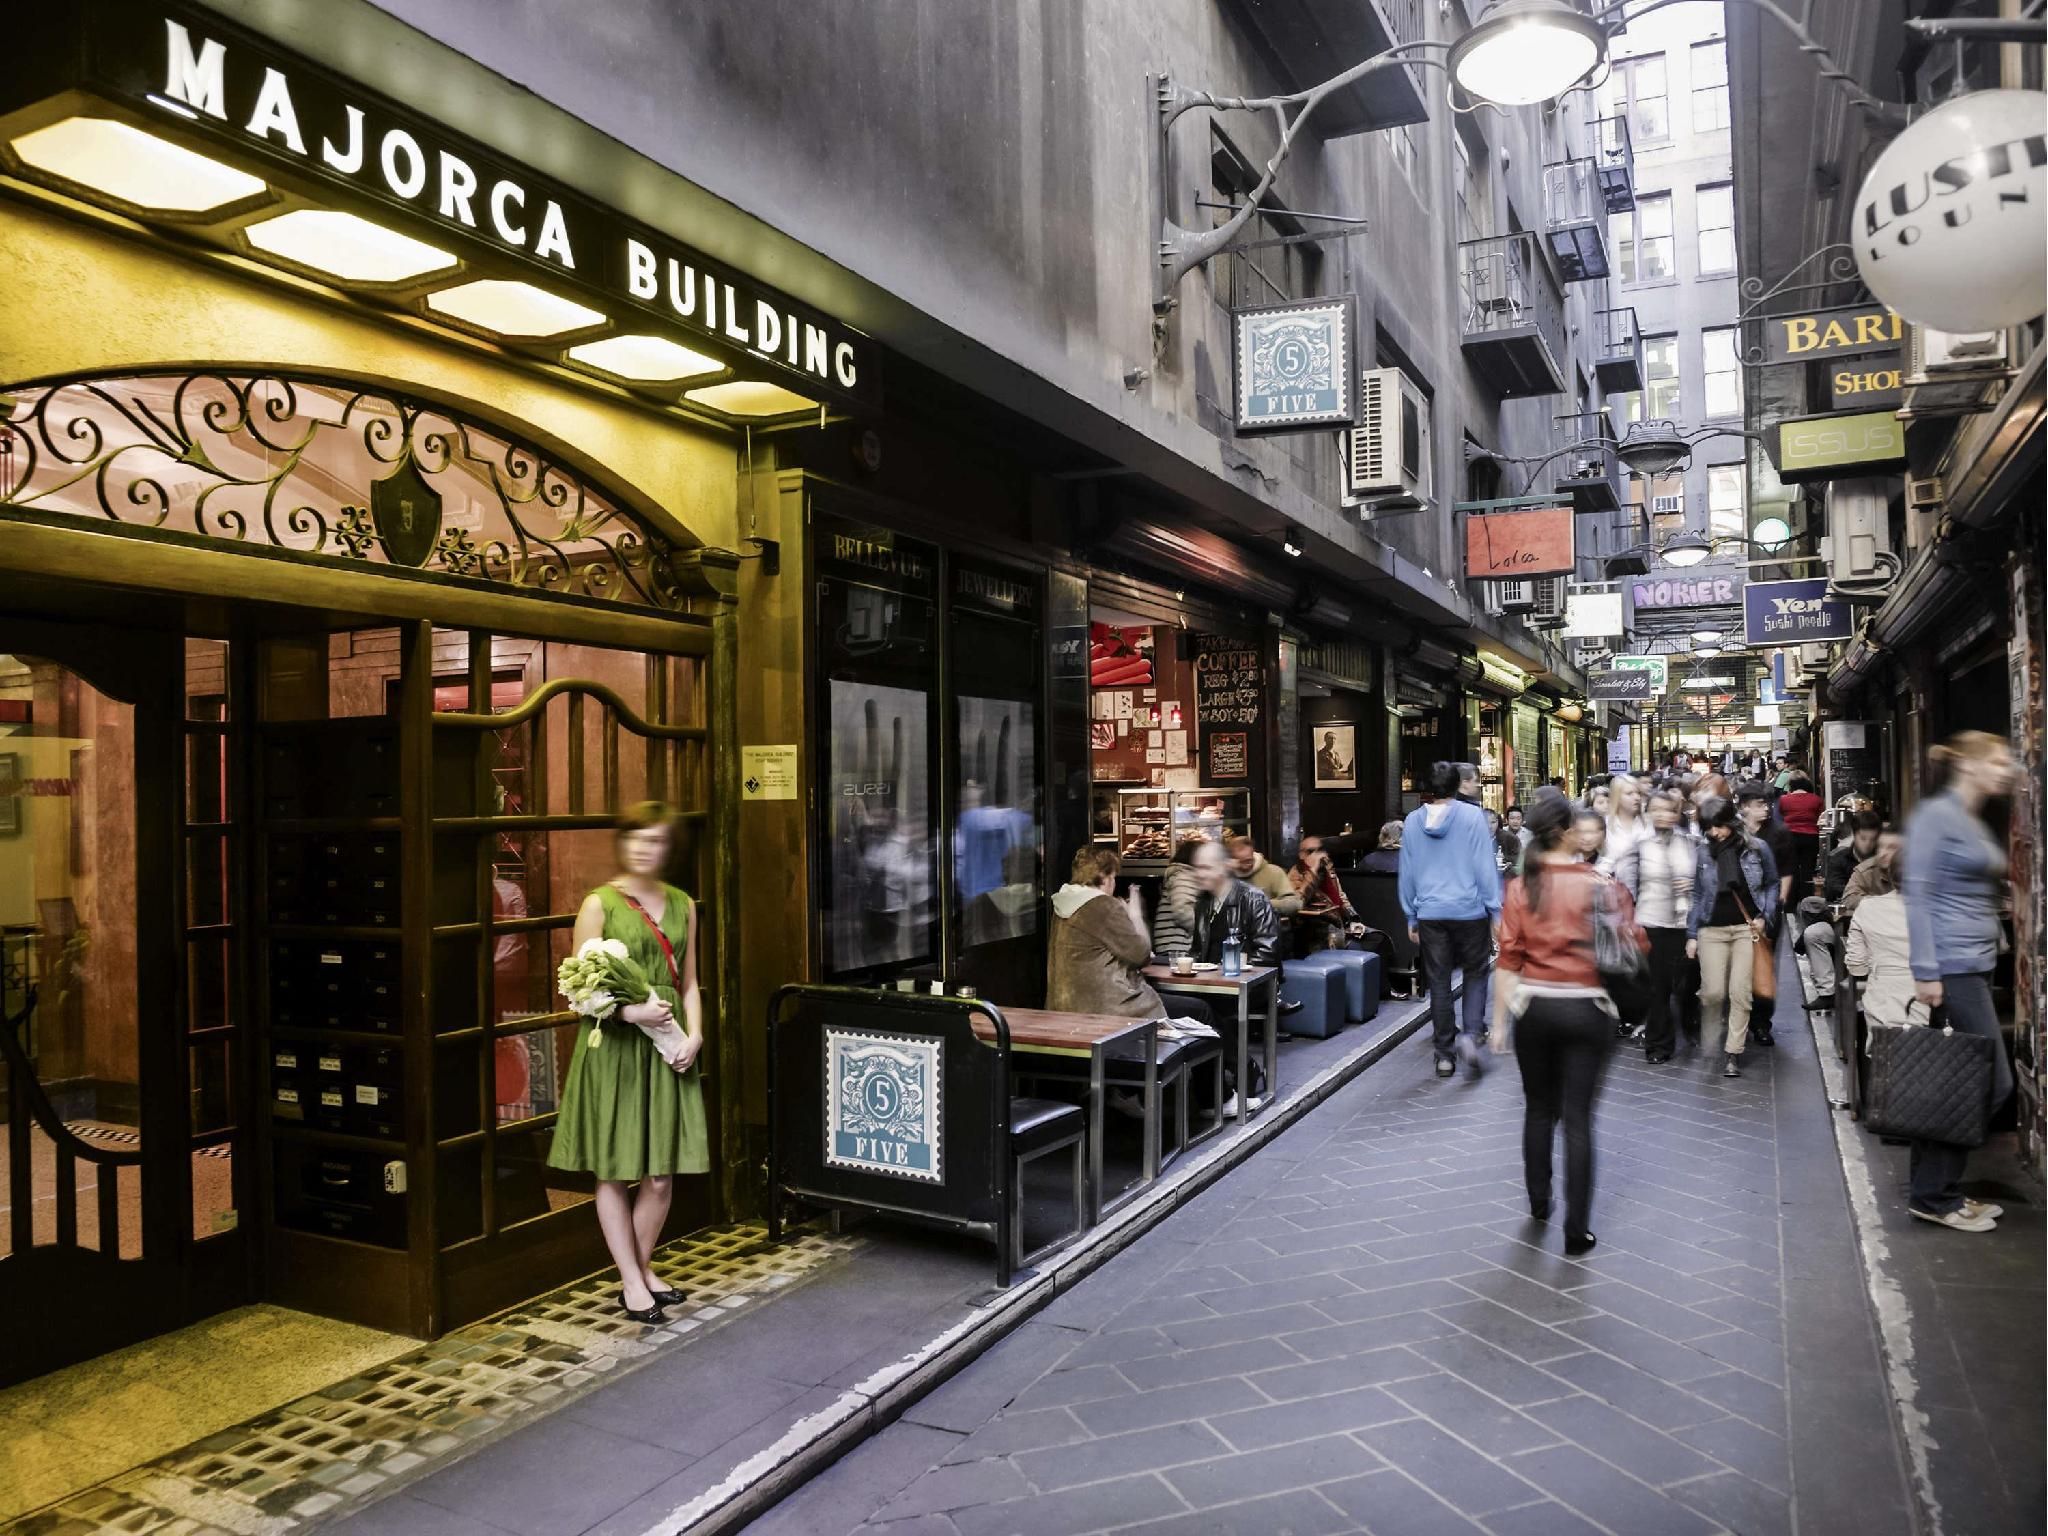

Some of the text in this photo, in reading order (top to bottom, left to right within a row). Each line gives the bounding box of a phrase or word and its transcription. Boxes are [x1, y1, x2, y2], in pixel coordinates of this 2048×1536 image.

[1866, 135, 2046, 237] LUST
[164, 18, 856, 388] MAJORCA BUILDING
[1285, 345, 1299, 372] 5
[1267, 393, 1317, 413] FIVE
[834, 534, 1033, 609] BELLEVUE JEWELLERY
[1633, 579, 1733, 607] NOKIER
[1771, 597, 1823, 615] Yen
[1764, 614, 1793, 632] Sushi
[1197, 650, 1258, 672] COFFEE
[1203, 673, 1229, 688] REG
[1198, 691, 1235, 707] LARGE
[1210, 708, 1234, 722] SOY
[874, 1080, 890, 1112] 5
[855, 1136, 909, 1166] FIVE
